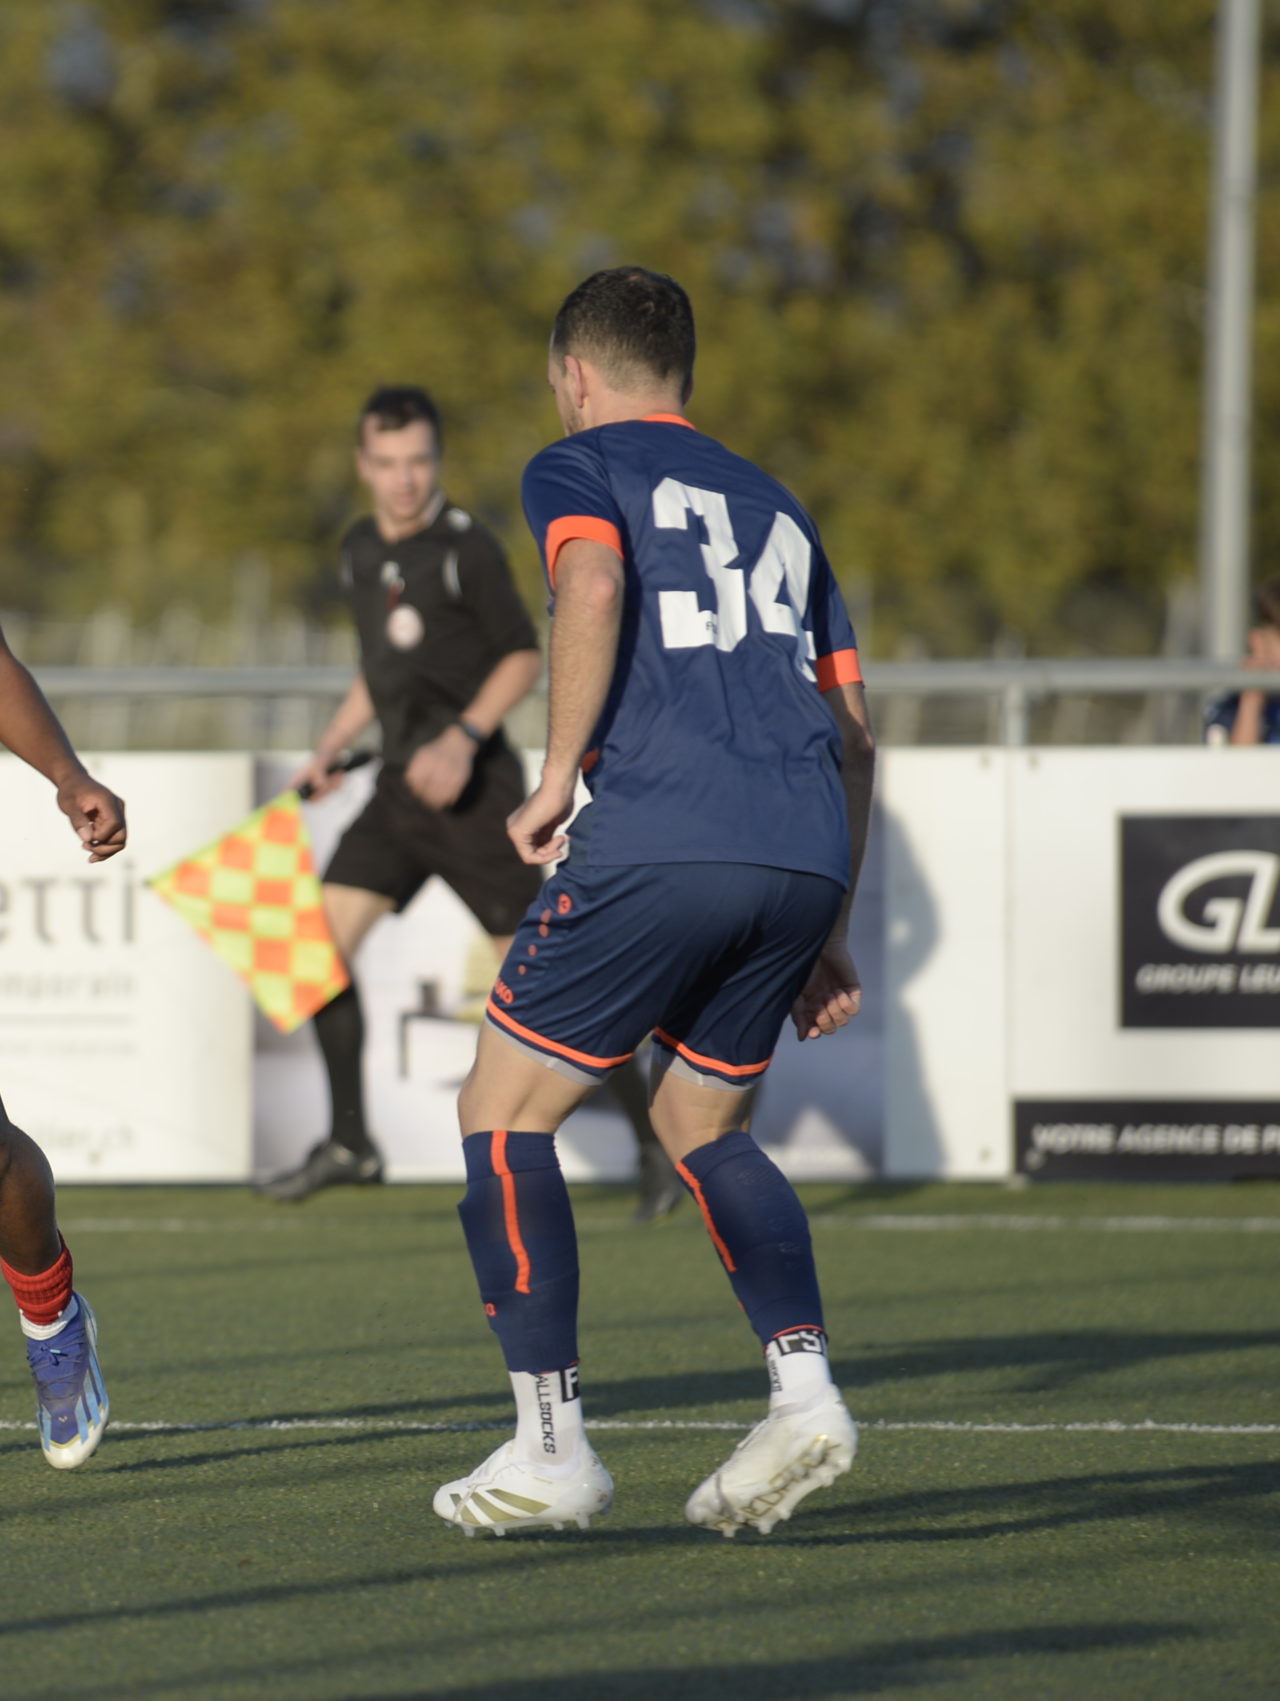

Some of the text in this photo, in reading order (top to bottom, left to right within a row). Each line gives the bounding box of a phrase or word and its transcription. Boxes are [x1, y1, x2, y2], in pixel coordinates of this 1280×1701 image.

[652, 476, 817, 682] 34
[1135, 962, 1238, 995] GROUPE
[1031, 1123, 1116, 1155] VOTRE
[1118, 1123, 1221, 1155] AGENCE
[1223, 1123, 1260, 1155] DE
[535, 1374, 556, 1455] ALLSOCKS
